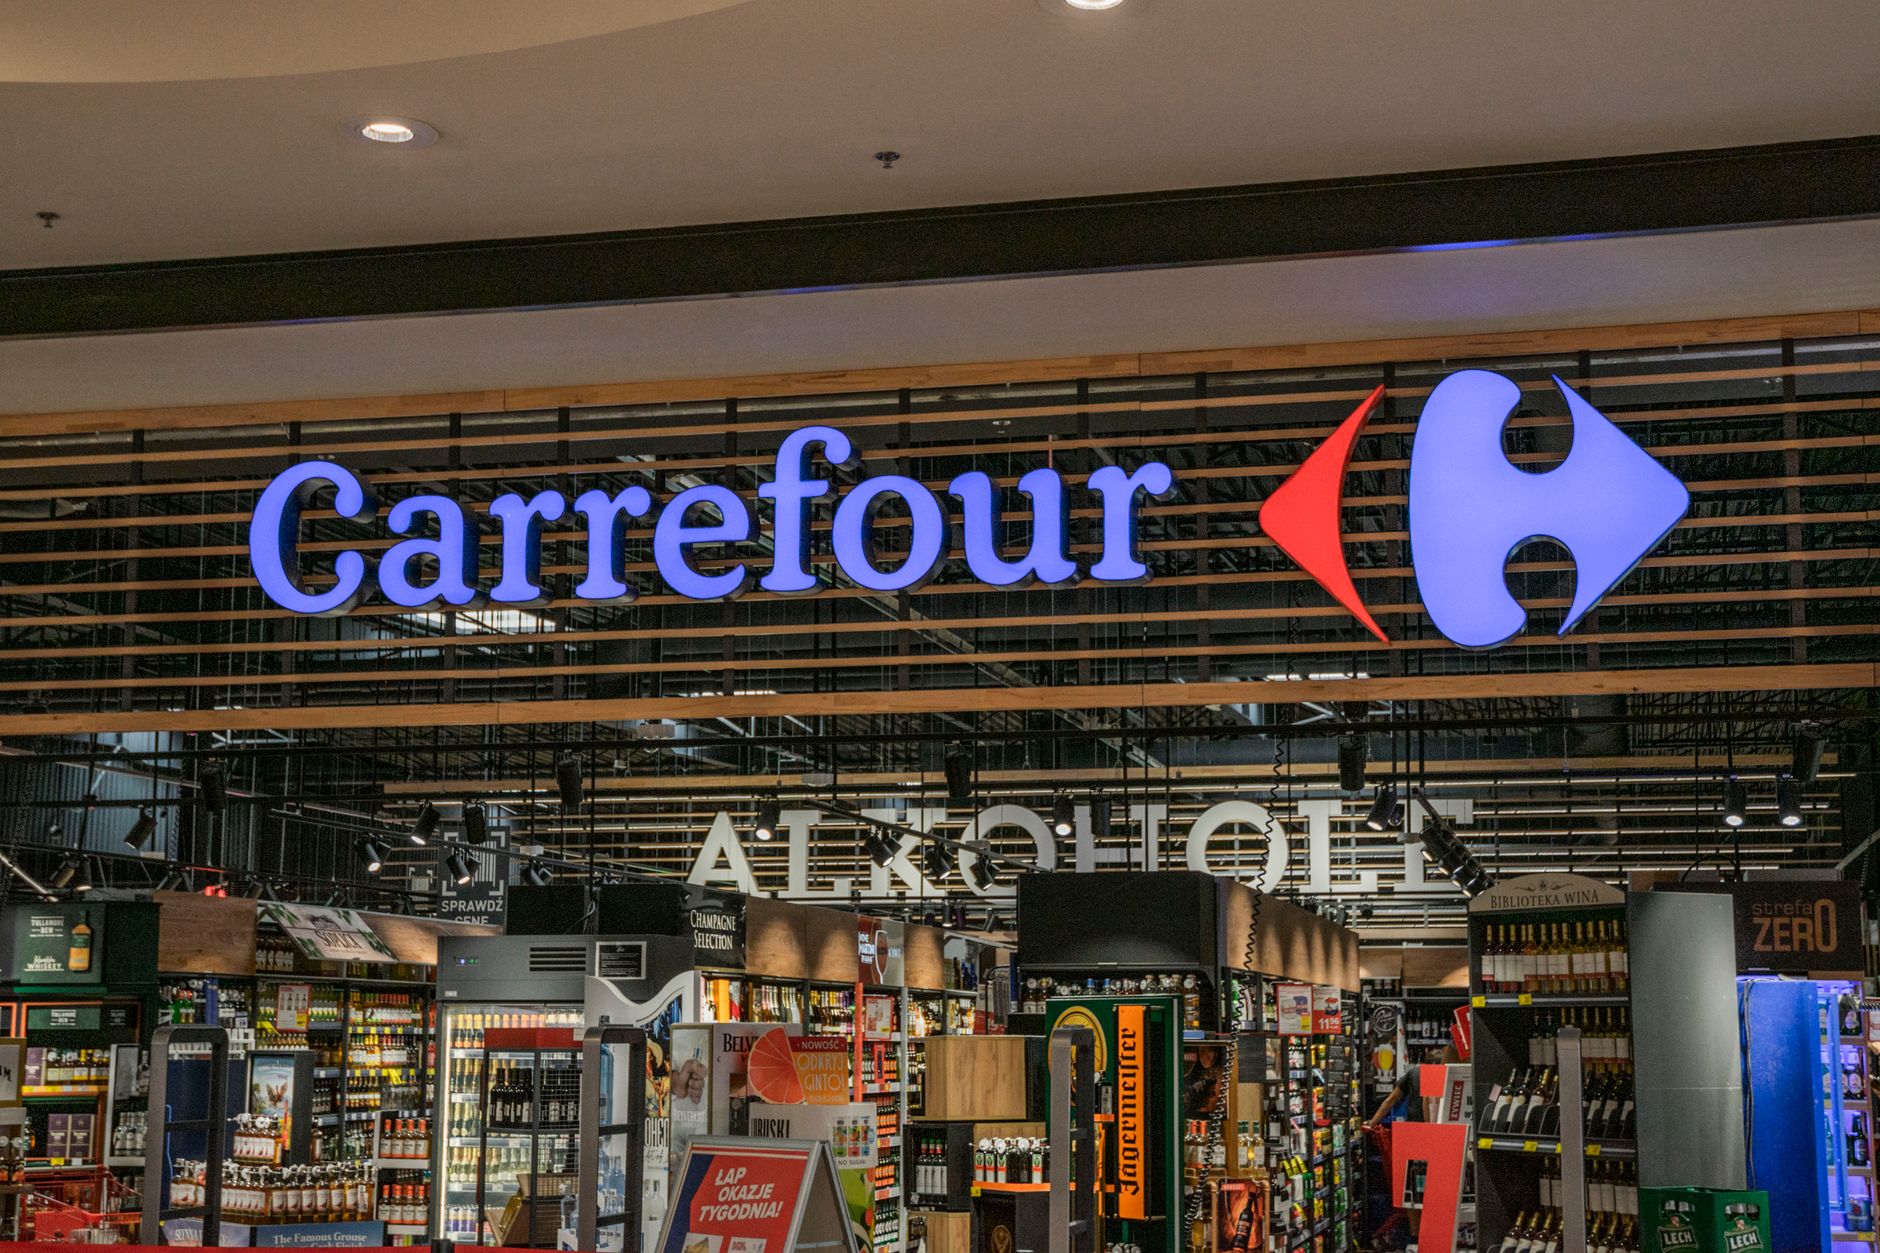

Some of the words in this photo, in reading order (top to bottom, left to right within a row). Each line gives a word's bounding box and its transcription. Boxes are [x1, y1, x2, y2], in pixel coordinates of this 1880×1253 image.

[249, 426, 1172, 614] Carrefour
[684, 797, 1475, 902] ALKOHOLE
[1490, 894, 1560, 909] BIBLIOTEKA
[1564, 889, 1599, 904] WINA
[1752, 899, 1813, 916] strefa
[1752, 898, 1838, 953] ZERO
[722, 1033, 758, 1053] BELV
[801, 1039, 839, 1050] NOWOŚĆ
[797, 1053, 844, 1071] ODKRYJ
[715, 1167, 747, 1186] ŁAP
[718, 1183, 775, 1202] OKAZJE
[699, 1201, 783, 1222] TYGODNIA!
[273, 1234, 292, 1244] The
[294, 1232, 332, 1243] Famous
[333, 1232, 368, 1242] Grouse
[1663, 1231, 1693, 1245] LECH
[1730, 1232, 1758, 1249] LECH
